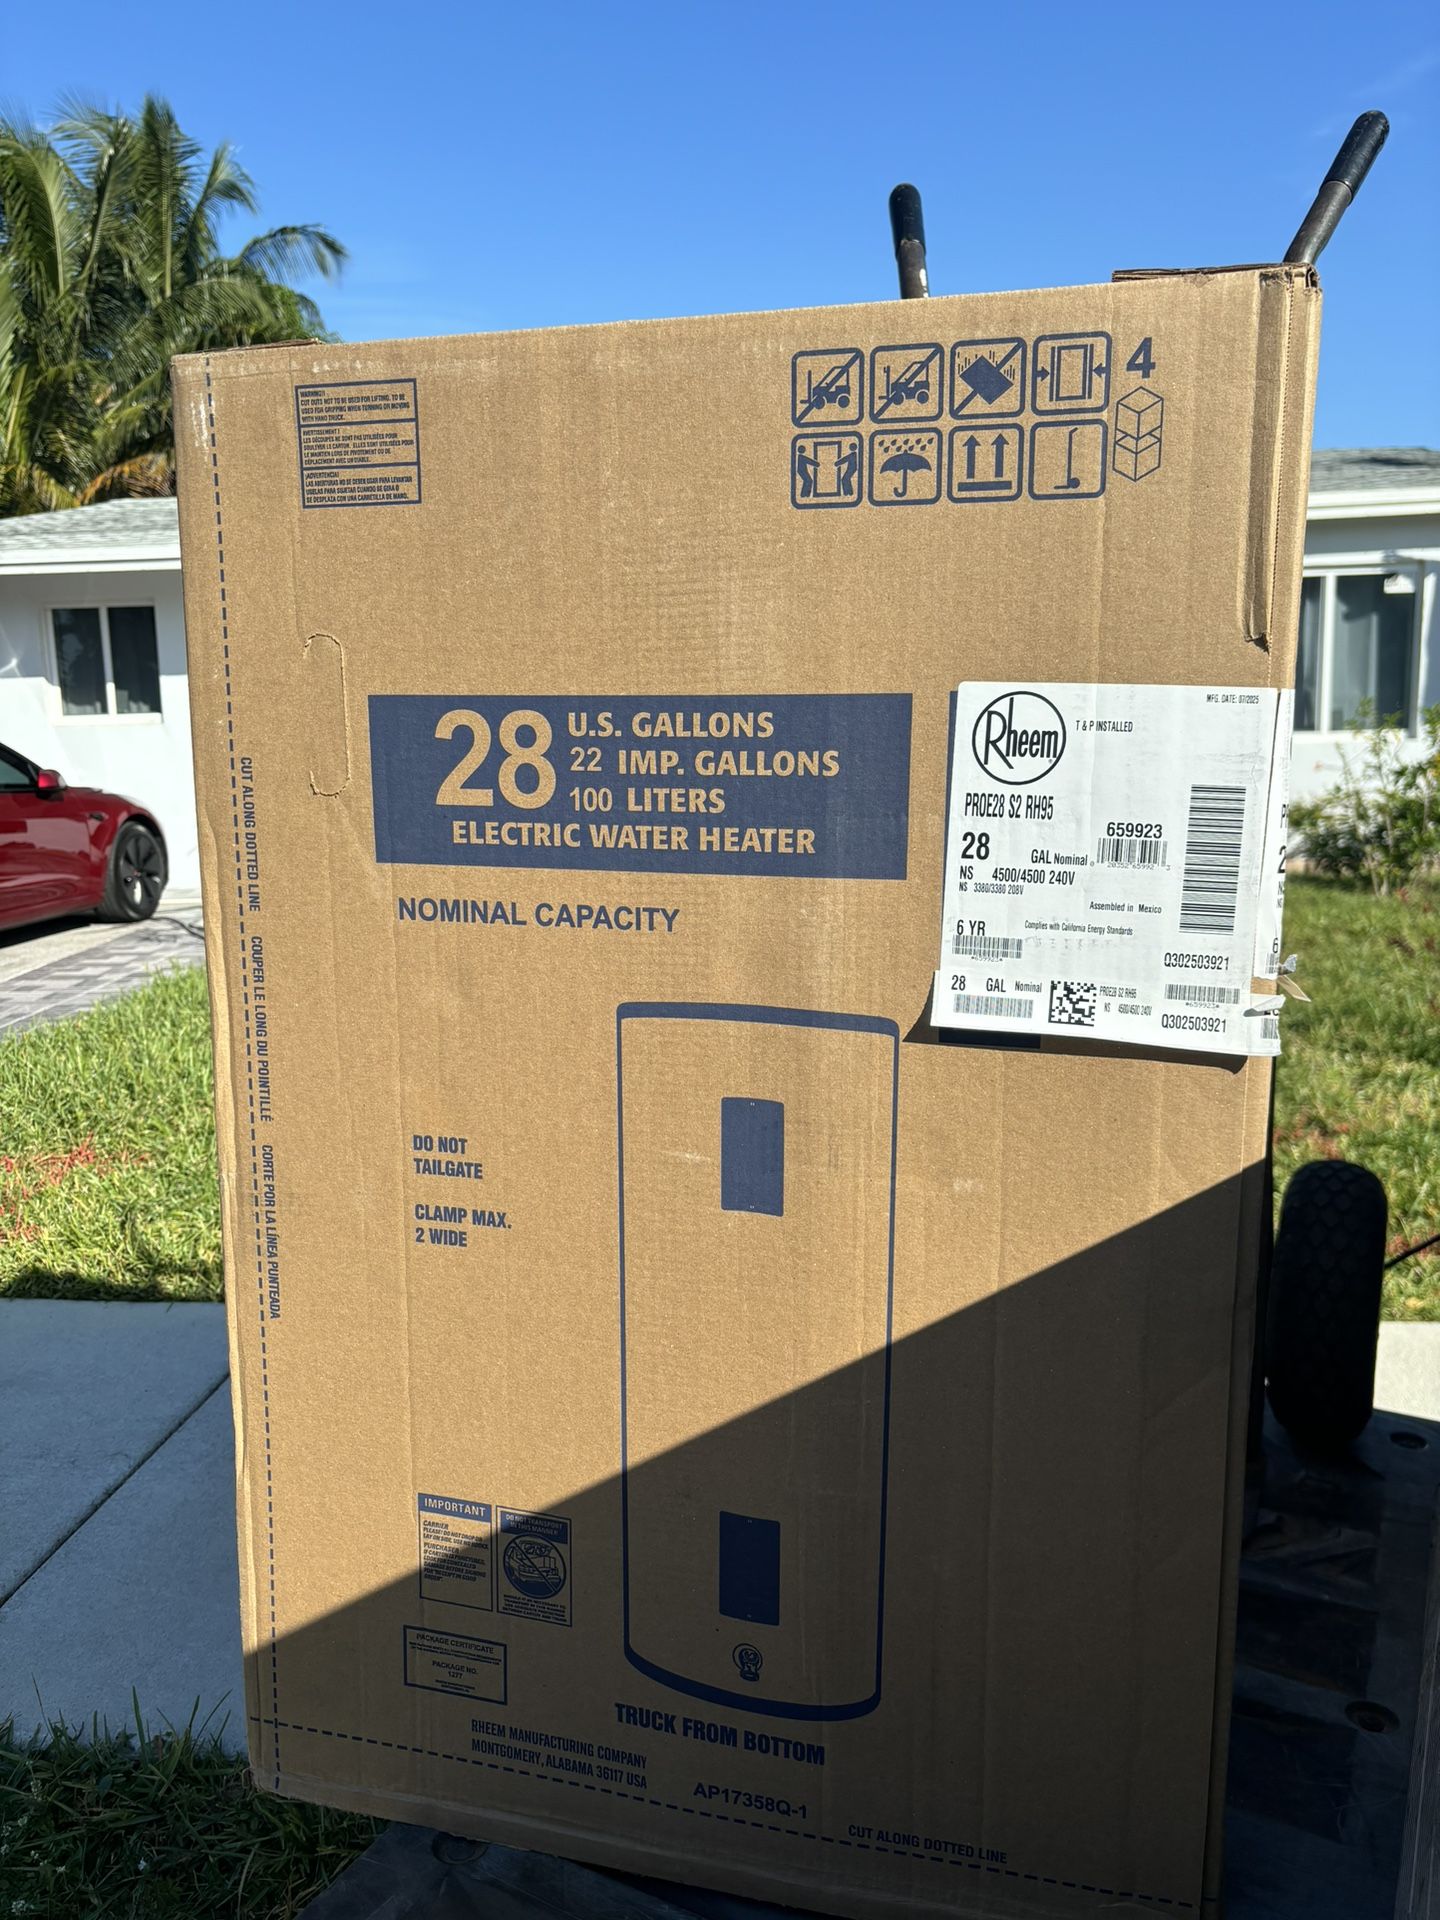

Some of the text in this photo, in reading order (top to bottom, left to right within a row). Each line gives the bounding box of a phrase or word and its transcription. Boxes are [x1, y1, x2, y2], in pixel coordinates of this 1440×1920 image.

[1126, 337, 1156, 378] 4
[984, 696, 1059, 769] Rheem
[1076, 720, 1133, 733] T & P INSTALLED
[434, 709, 774, 810] 28 U.S. GALLONS
[570, 747, 841, 777] 22 IMP. GALLONS
[570, 787, 725, 814] 100 LITERS
[964, 792, 1054, 821] PROE28 S2 RH95
[240, 757, 261, 912] CUT ALONG DOTTED LINE
[452, 820, 816, 854] ELECTRIC WATER HEATER
[1106, 821, 1162, 839] 659923
[961, 832, 991, 861] 28
[1031, 849, 1088, 867] GAL Nominal
[958, 881, 1024, 895] NS 3380/3380 208V
[959, 866, 1076, 886] NS 4500/4500 240V
[398, 897, 680, 933] NOMINAL CAPACITY
[1090, 901, 1162, 914] Assembled in Mexico
[956, 919, 986, 936] 6 YR
[1024, 920, 1133, 936] Complies with California Energy Standards
[1164, 952, 1229, 971] Q302503921
[951, 975, 1042, 993] 28 GAL Nominal
[251, 936, 273, 1122] COUPER LE LONG DU POINTILLÉ
[1161, 1013, 1227, 1033] Q302503921
[413, 1134, 468, 1154] DO NOT
[413, 1158, 483, 1180] TAILGATE
[415, 1204, 512, 1229] CLAMP MAX.
[262, 1144, 281, 1319] CORTE POR LA LÍNEA PUNTEADA
[415, 1227, 467, 1247] 2 WIDE
[424, 1498, 486, 1517] IMPORTANT
[416, 1633, 449, 1644] PACKAGE
[450, 1640, 494, 1654] CERTIFICATE
[432, 1660, 465, 1672] PACKAGE
[471, 1719, 647, 1770] RHEEM MANUFACTURING COMPANY
[615, 1702, 825, 1765] TRUCK FROM BOTTOM
[471, 1738, 648, 1789] MONTGOMERY, ALABAMA 36117 USA
[693, 1782, 808, 1819] AP17358Q-1
[848, 1824, 1007, 1864] CUT ALONG DOTTED LINE
